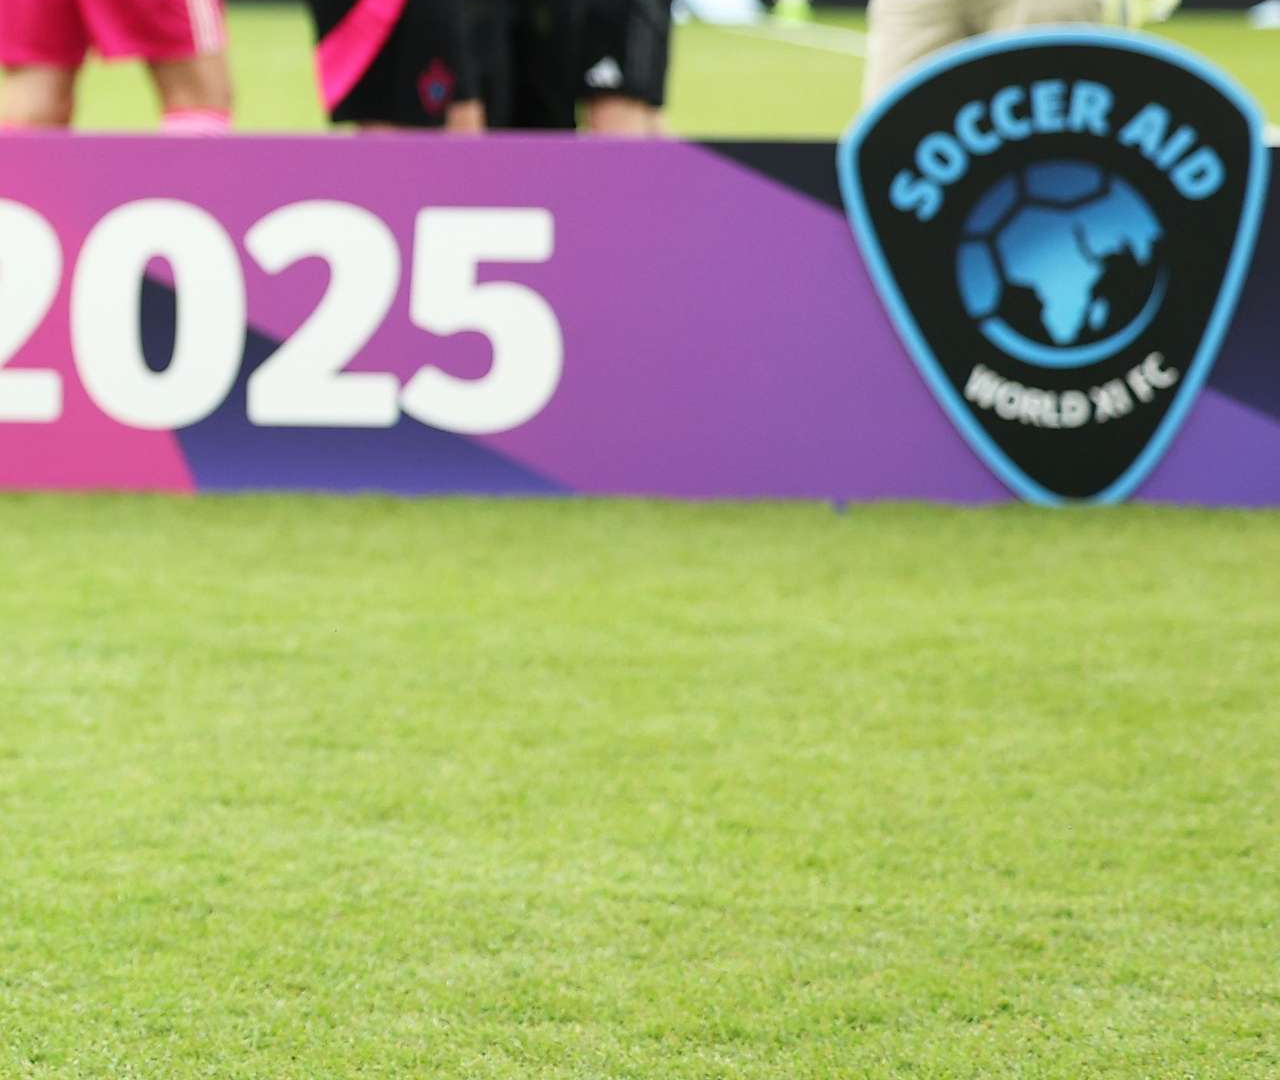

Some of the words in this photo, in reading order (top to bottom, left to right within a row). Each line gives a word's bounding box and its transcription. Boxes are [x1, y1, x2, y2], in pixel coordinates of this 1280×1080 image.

[890, 80, 1115, 221] SOCCER
[1119, 102, 1226, 201] AID
[964, 364, 1091, 429] WORLD
[1126, 351, 1180, 403] FC
